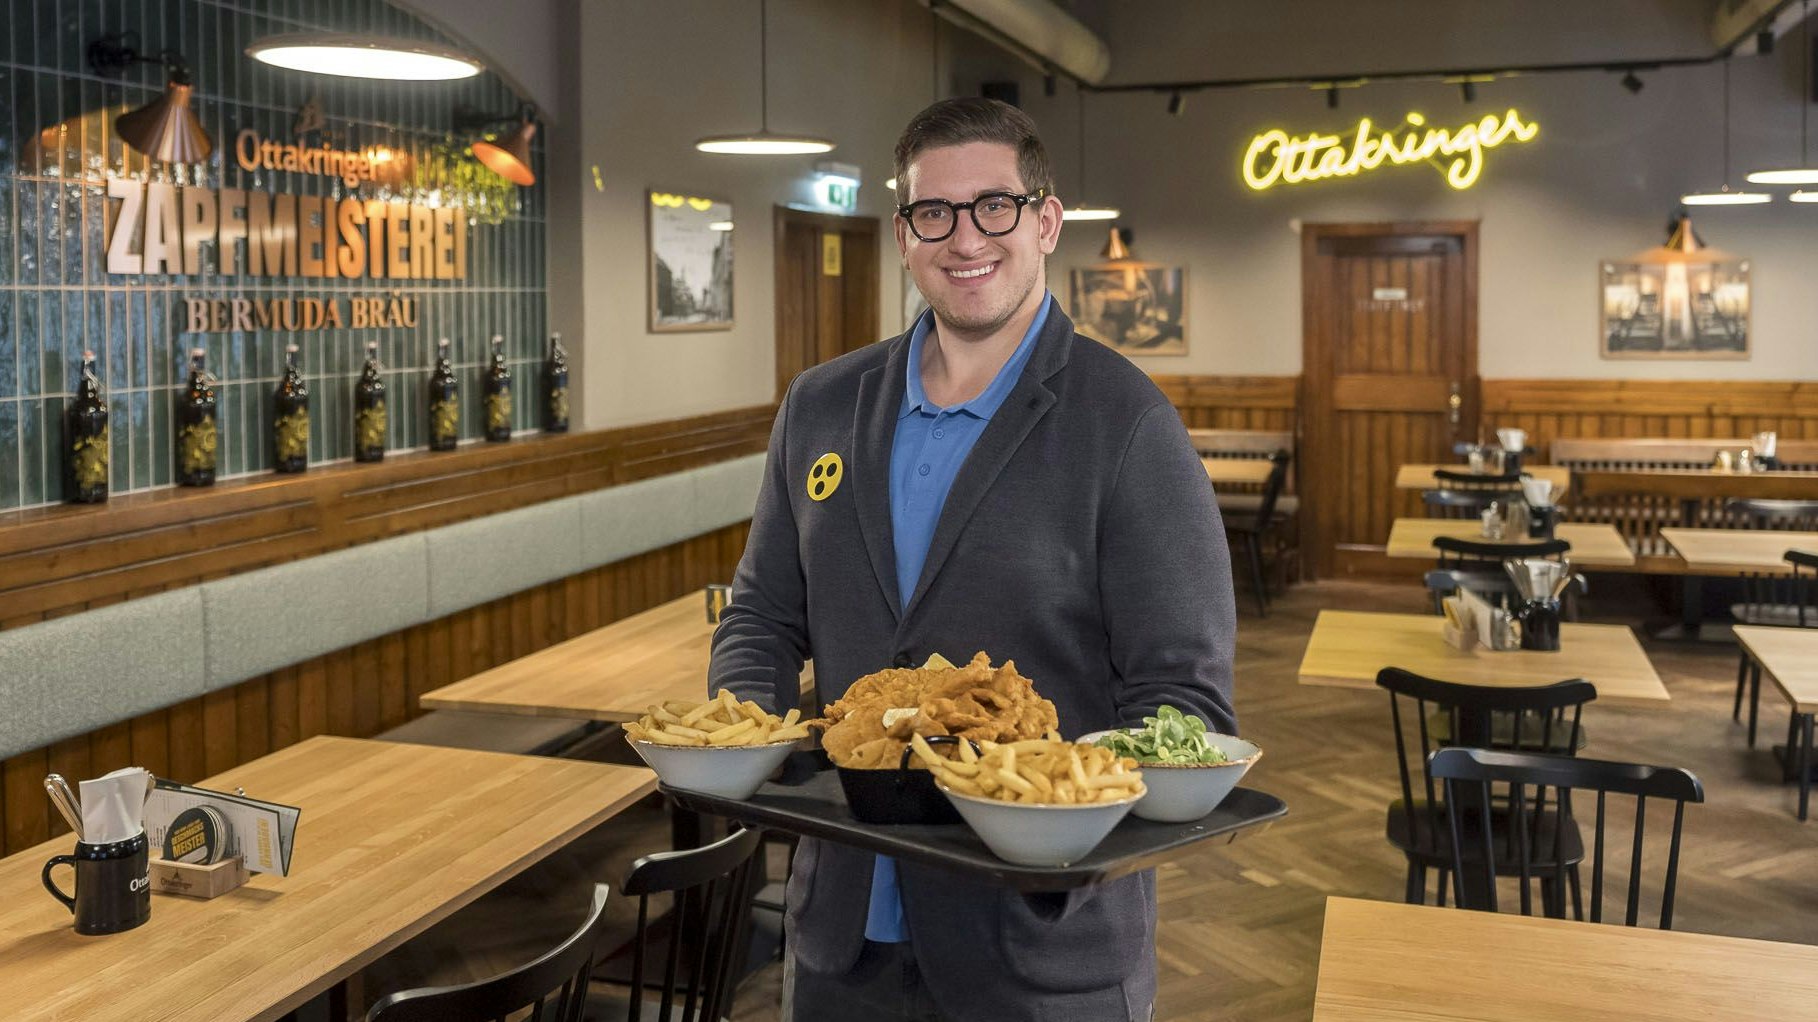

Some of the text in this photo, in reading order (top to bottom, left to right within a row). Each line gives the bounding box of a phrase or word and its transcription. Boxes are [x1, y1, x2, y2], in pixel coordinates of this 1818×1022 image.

[236, 128, 381, 189] Ottakringer
[1243, 109, 1538, 190] Ottakringer
[106, 178, 466, 280] ZAPFMEISTEREI
[186, 289, 419, 333] BERMUDA BRÄU
[172, 832, 206, 858] MEISTER
